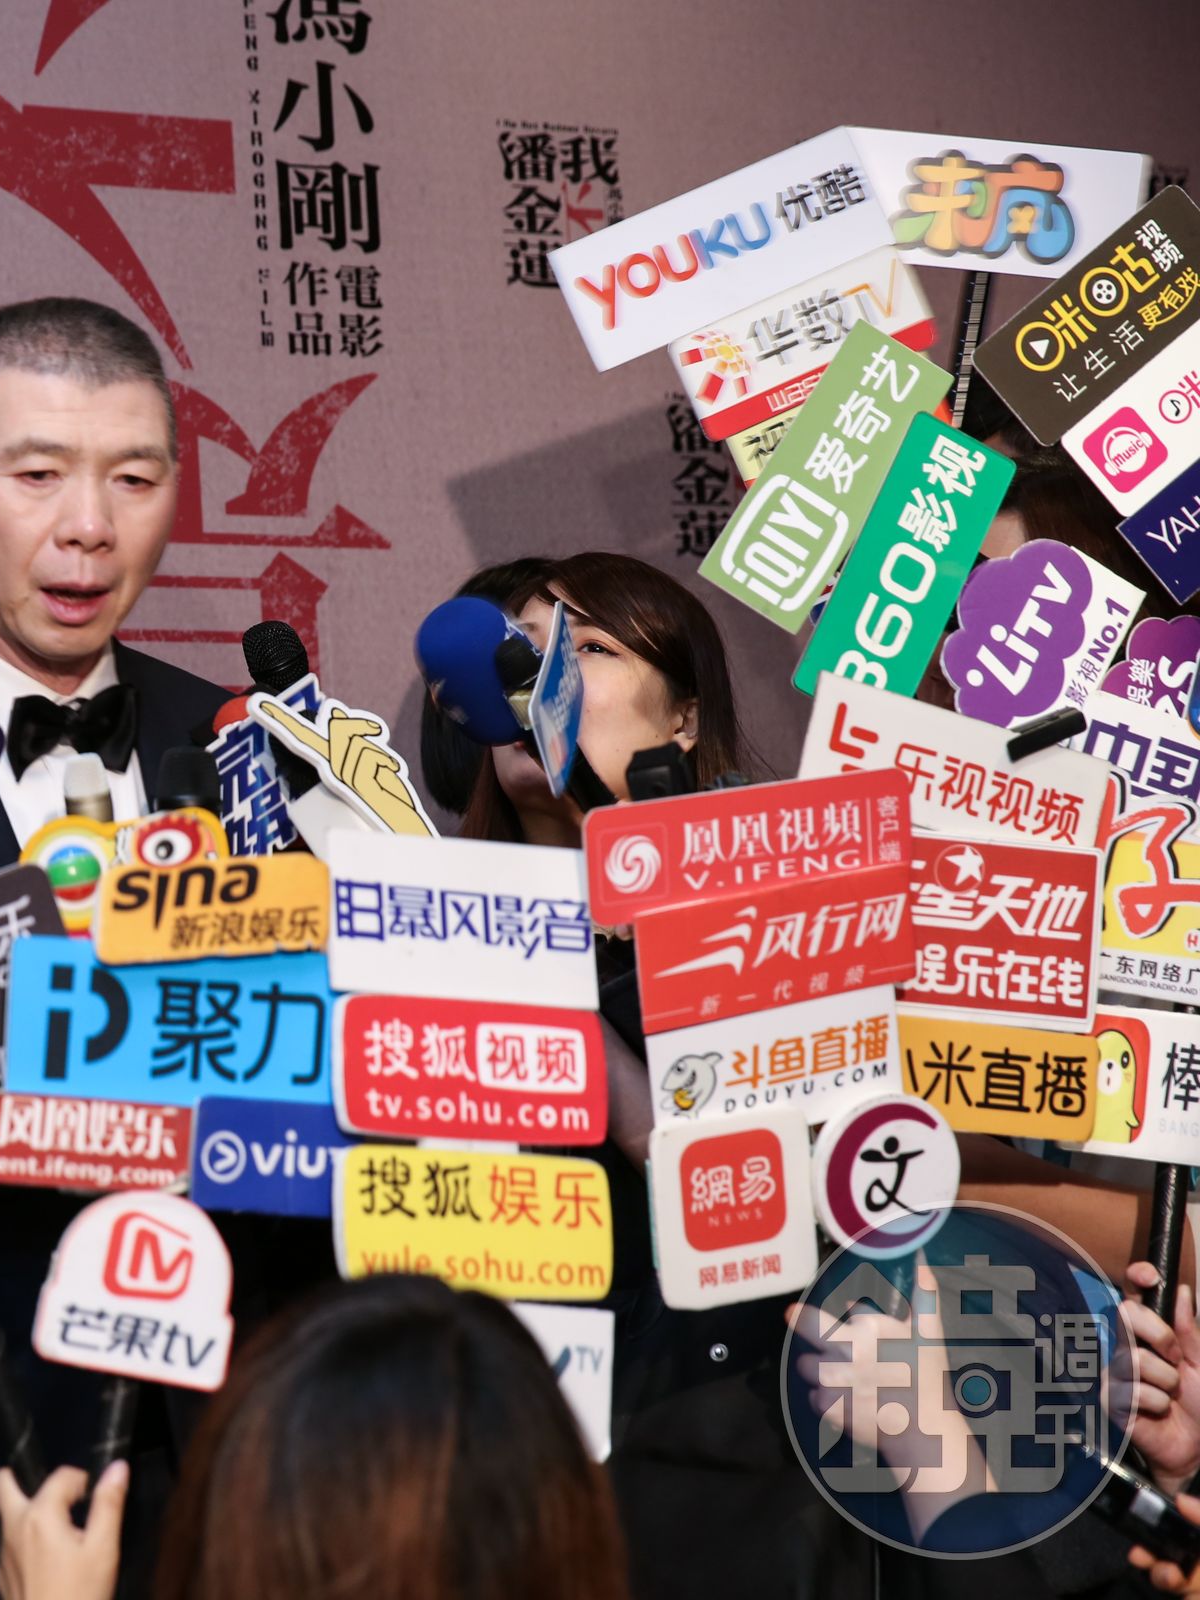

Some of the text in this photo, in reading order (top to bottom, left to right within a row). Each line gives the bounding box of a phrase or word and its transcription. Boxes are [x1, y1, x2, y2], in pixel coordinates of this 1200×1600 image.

[574, 163, 867, 331] YOUKU 优酷
[804, 344, 922, 494] 爱奇艺
[895, 740, 1087, 846] 乐视视频
[112, 863, 260, 931] sina
[682, 849, 862, 891] V.IFENG
[169, 904, 321, 951] 新浪娱乐
[752, 892, 907, 969] 风行网
[149, 976, 327, 1086] 聚力
[363, 1017, 579, 1086] 搜狐视频
[724, 1013, 891, 1090] 斗鱼直播
[365, 1088, 591, 1131] tv.sohu.com
[724, 1061, 889, 1115] DOUYU.COM
[359, 1154, 604, 1230] 搜狐娱乐
[690, 1155, 777, 1216] 網易
[707, 1207, 764, 1228] NEWS
[698, 1253, 783, 1290] 网易新闻
